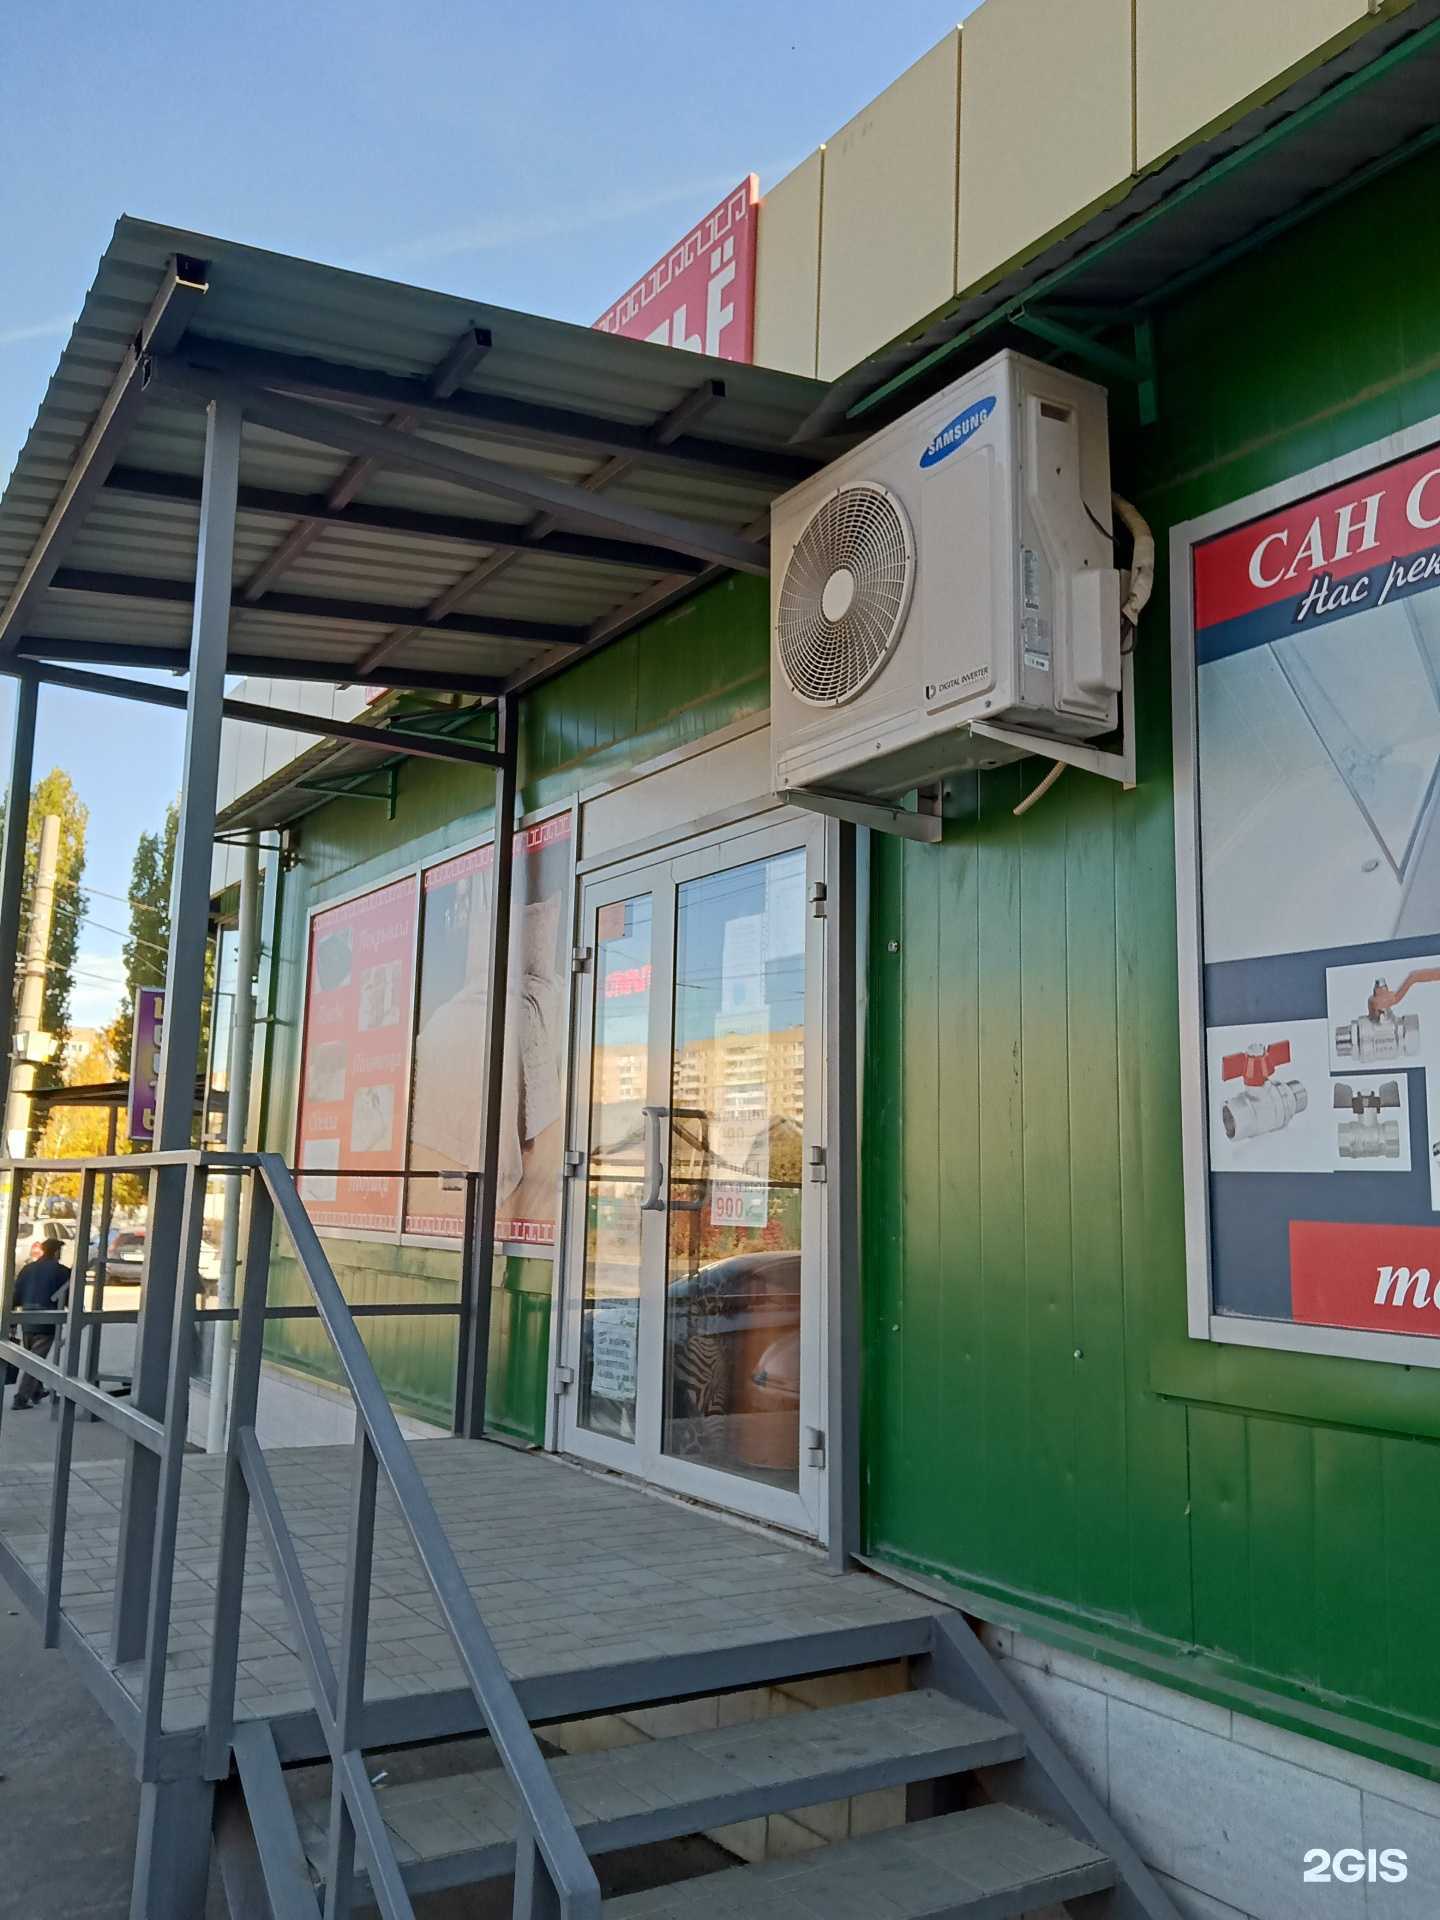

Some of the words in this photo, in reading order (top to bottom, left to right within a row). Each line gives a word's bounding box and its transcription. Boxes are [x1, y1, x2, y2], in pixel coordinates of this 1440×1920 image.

[927, 408, 989, 456] SAMSUNG
[1248, 490, 1386, 589] САН
[1297, 577, 1369, 621] Нас
[938, 678, 961, 692] DIGITAL
[961, 665, 989, 684] INVERTER
[716, 1197, 744, 1219] 900
